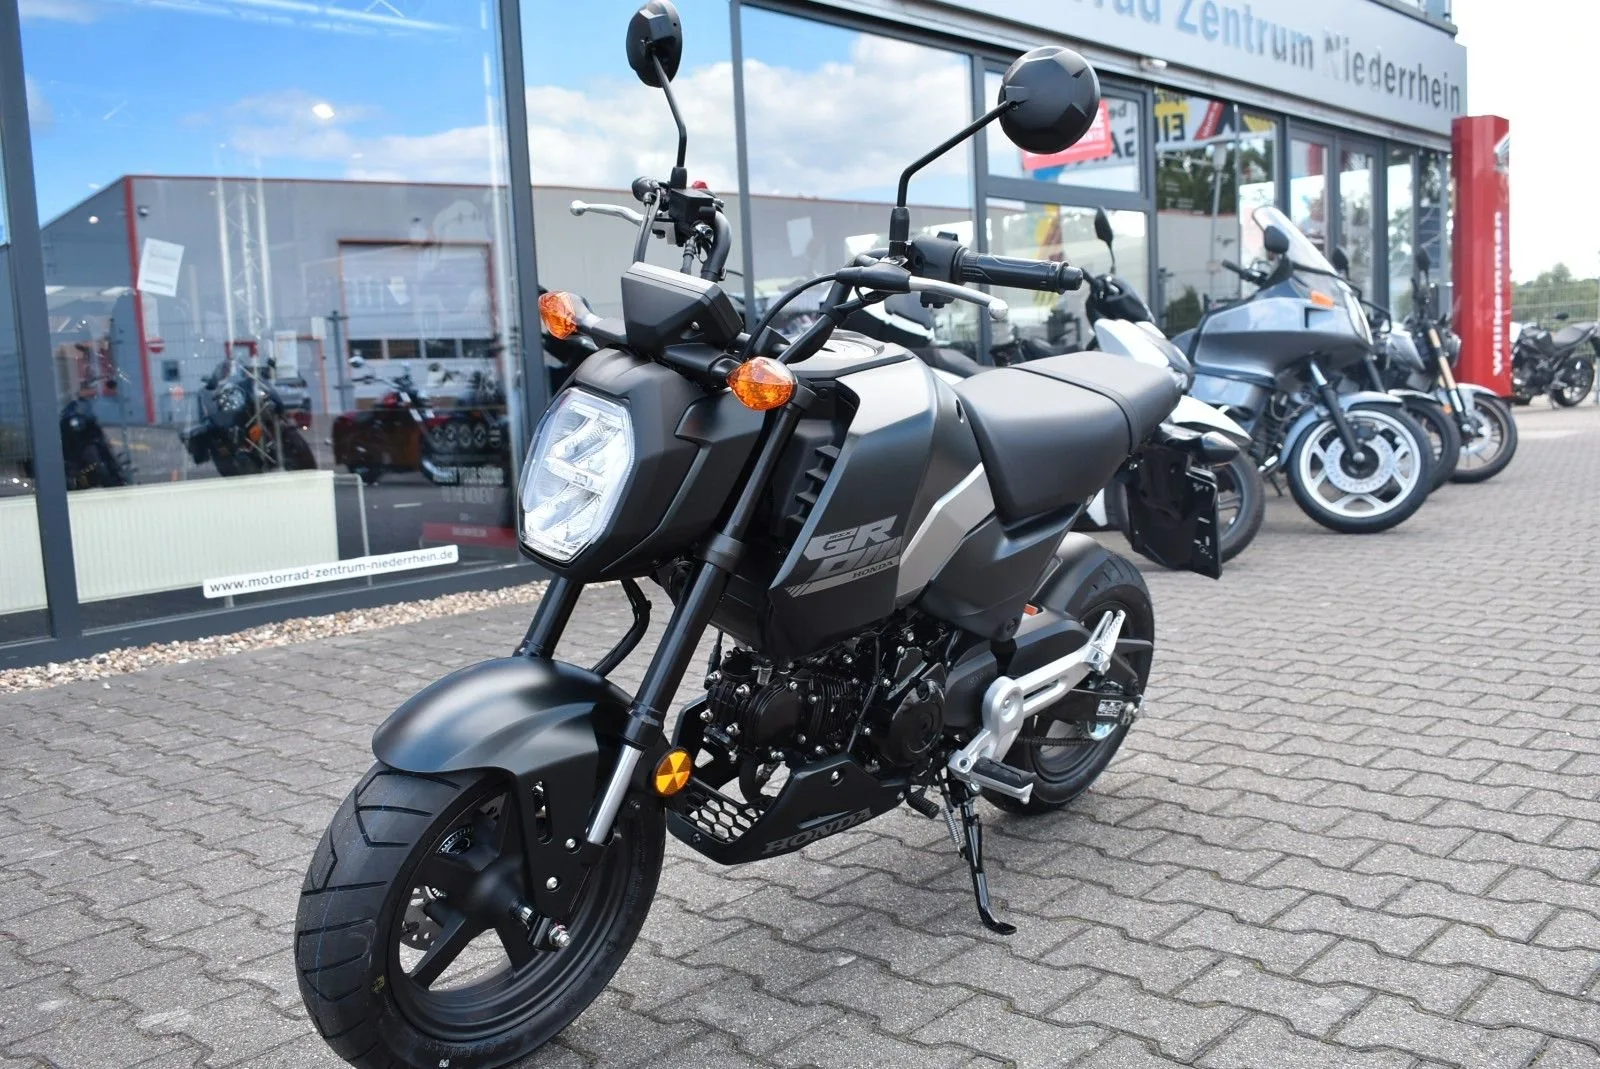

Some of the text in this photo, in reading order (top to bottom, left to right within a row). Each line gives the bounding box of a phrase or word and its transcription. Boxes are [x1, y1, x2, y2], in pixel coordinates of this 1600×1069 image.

[1178, 0, 1461, 113] Zentrum Niederrhein
[209, 550, 454, 593] www.motorrad-zentrum-niederrhein.de
[851, 559, 894, 579] HONDA
[761, 807, 874, 854] HONDA
